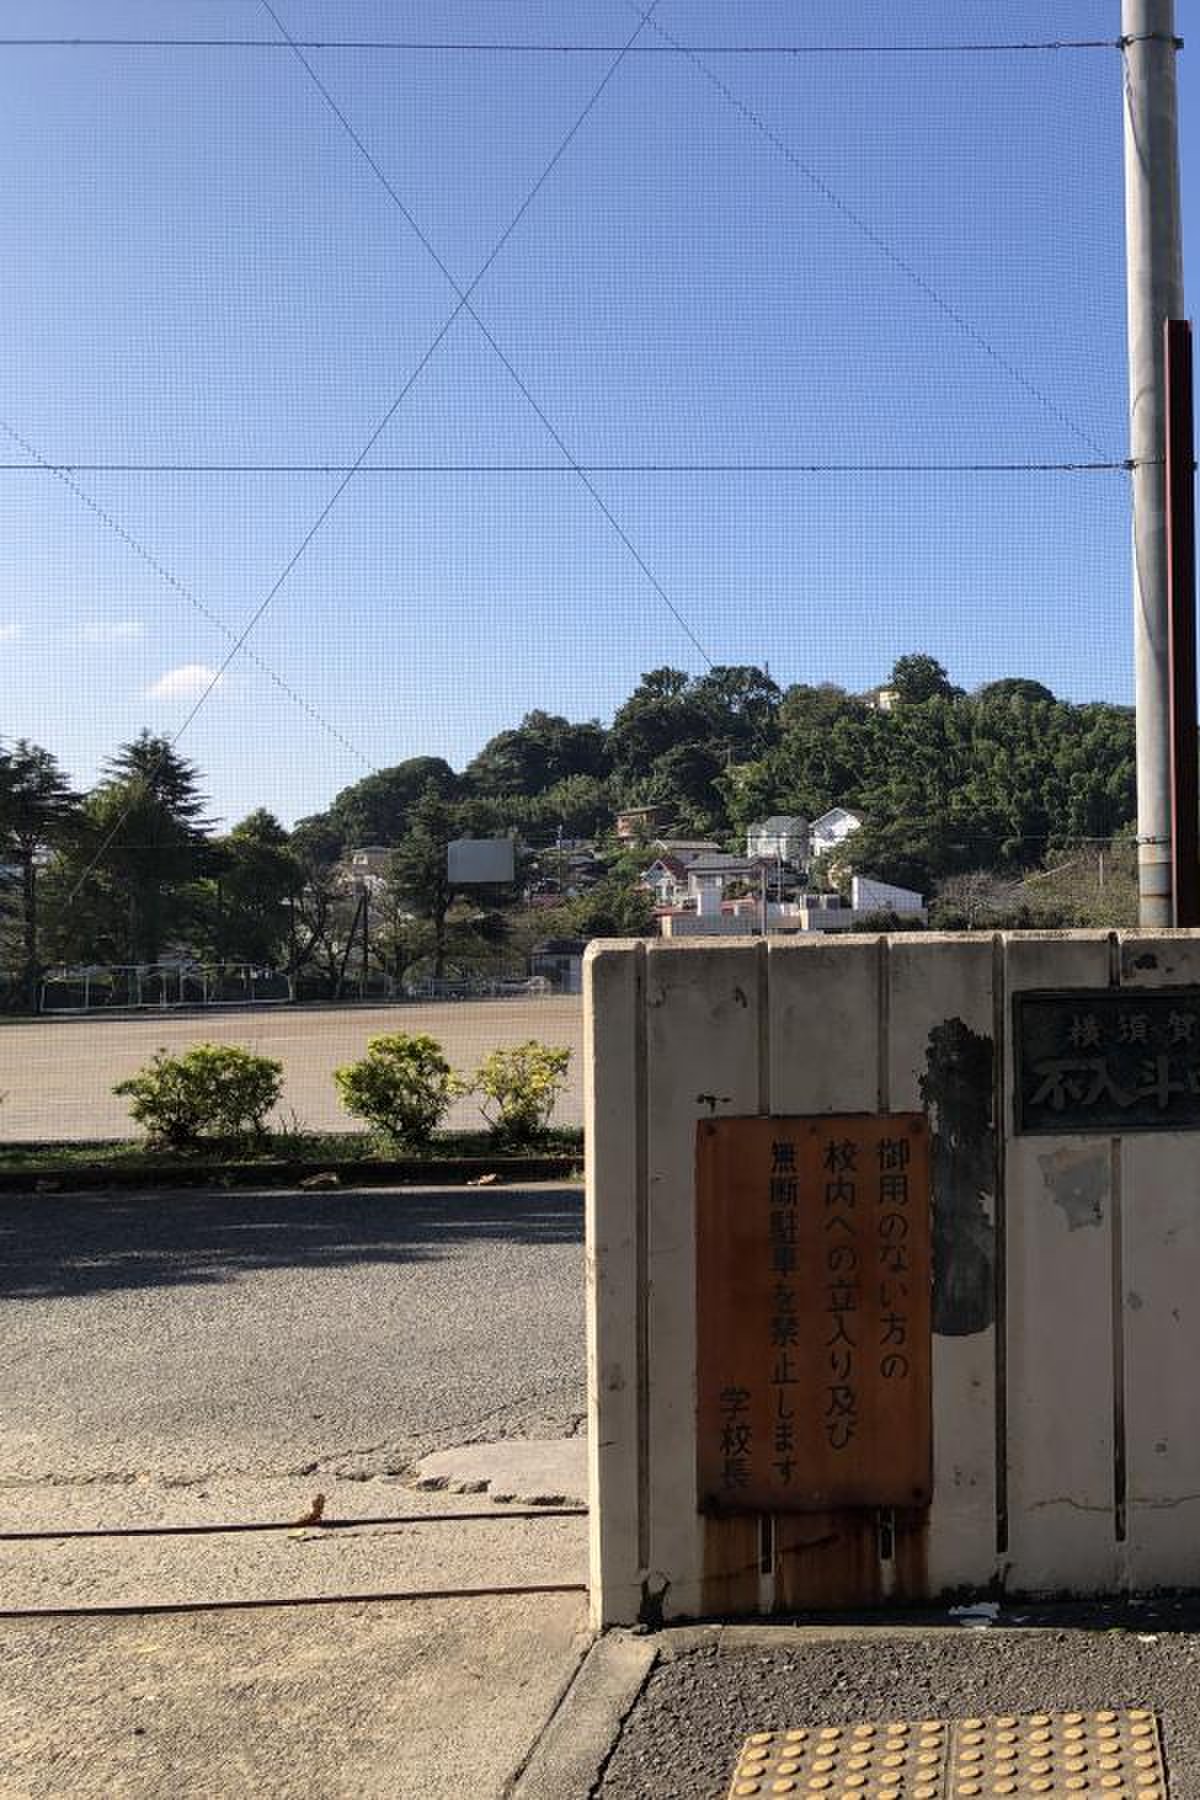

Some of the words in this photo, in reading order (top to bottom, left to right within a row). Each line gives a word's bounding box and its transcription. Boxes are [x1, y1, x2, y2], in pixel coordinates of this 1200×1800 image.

[769, 1140, 800, 1486] 無断駐車を禁止します
[823, 1139, 860, 1450] 校内への立入り及び
[876, 1137, 910, 1380] 御用のない方の
[718, 1386, 753, 1490] 学校長
